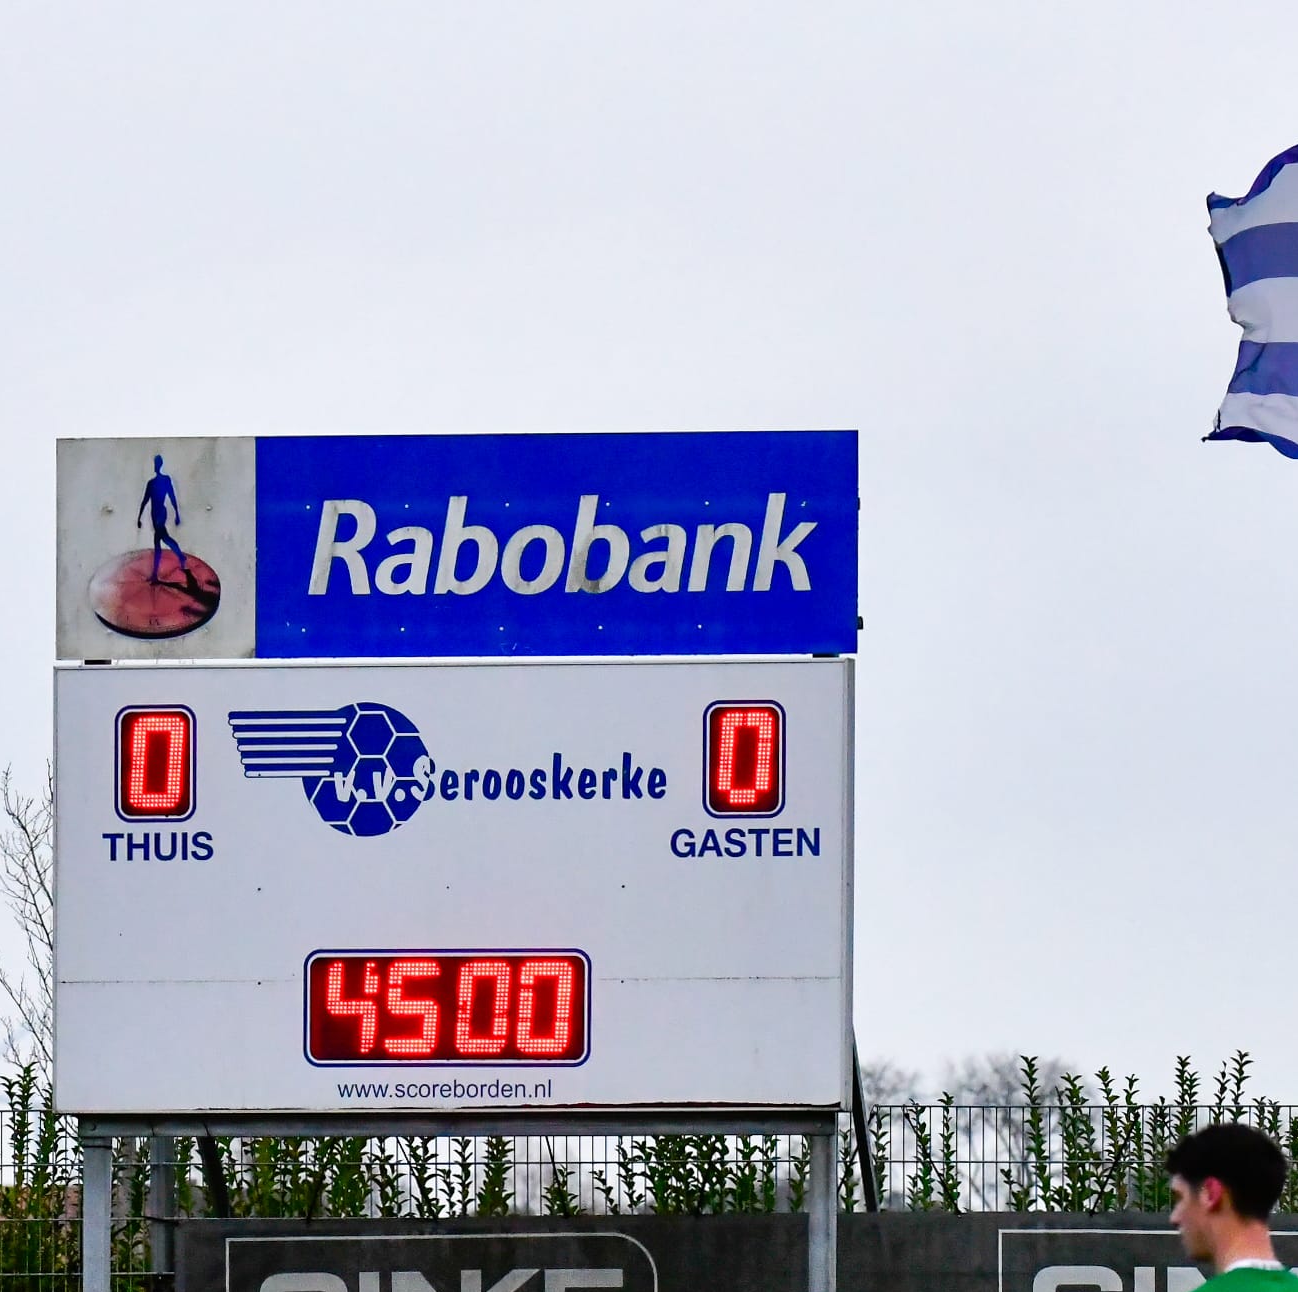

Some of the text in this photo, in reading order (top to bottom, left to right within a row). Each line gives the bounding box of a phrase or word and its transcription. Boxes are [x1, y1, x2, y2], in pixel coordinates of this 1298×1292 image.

[306, 493, 817, 595] Rabobank
[127, 714, 185, 809] 0
[714, 710, 773, 805] 0
[102, 832, 214, 861] THUIS
[670, 827, 821, 858] GASTEN
[338, 1079, 552, 1099] www.scoreborden.nl
